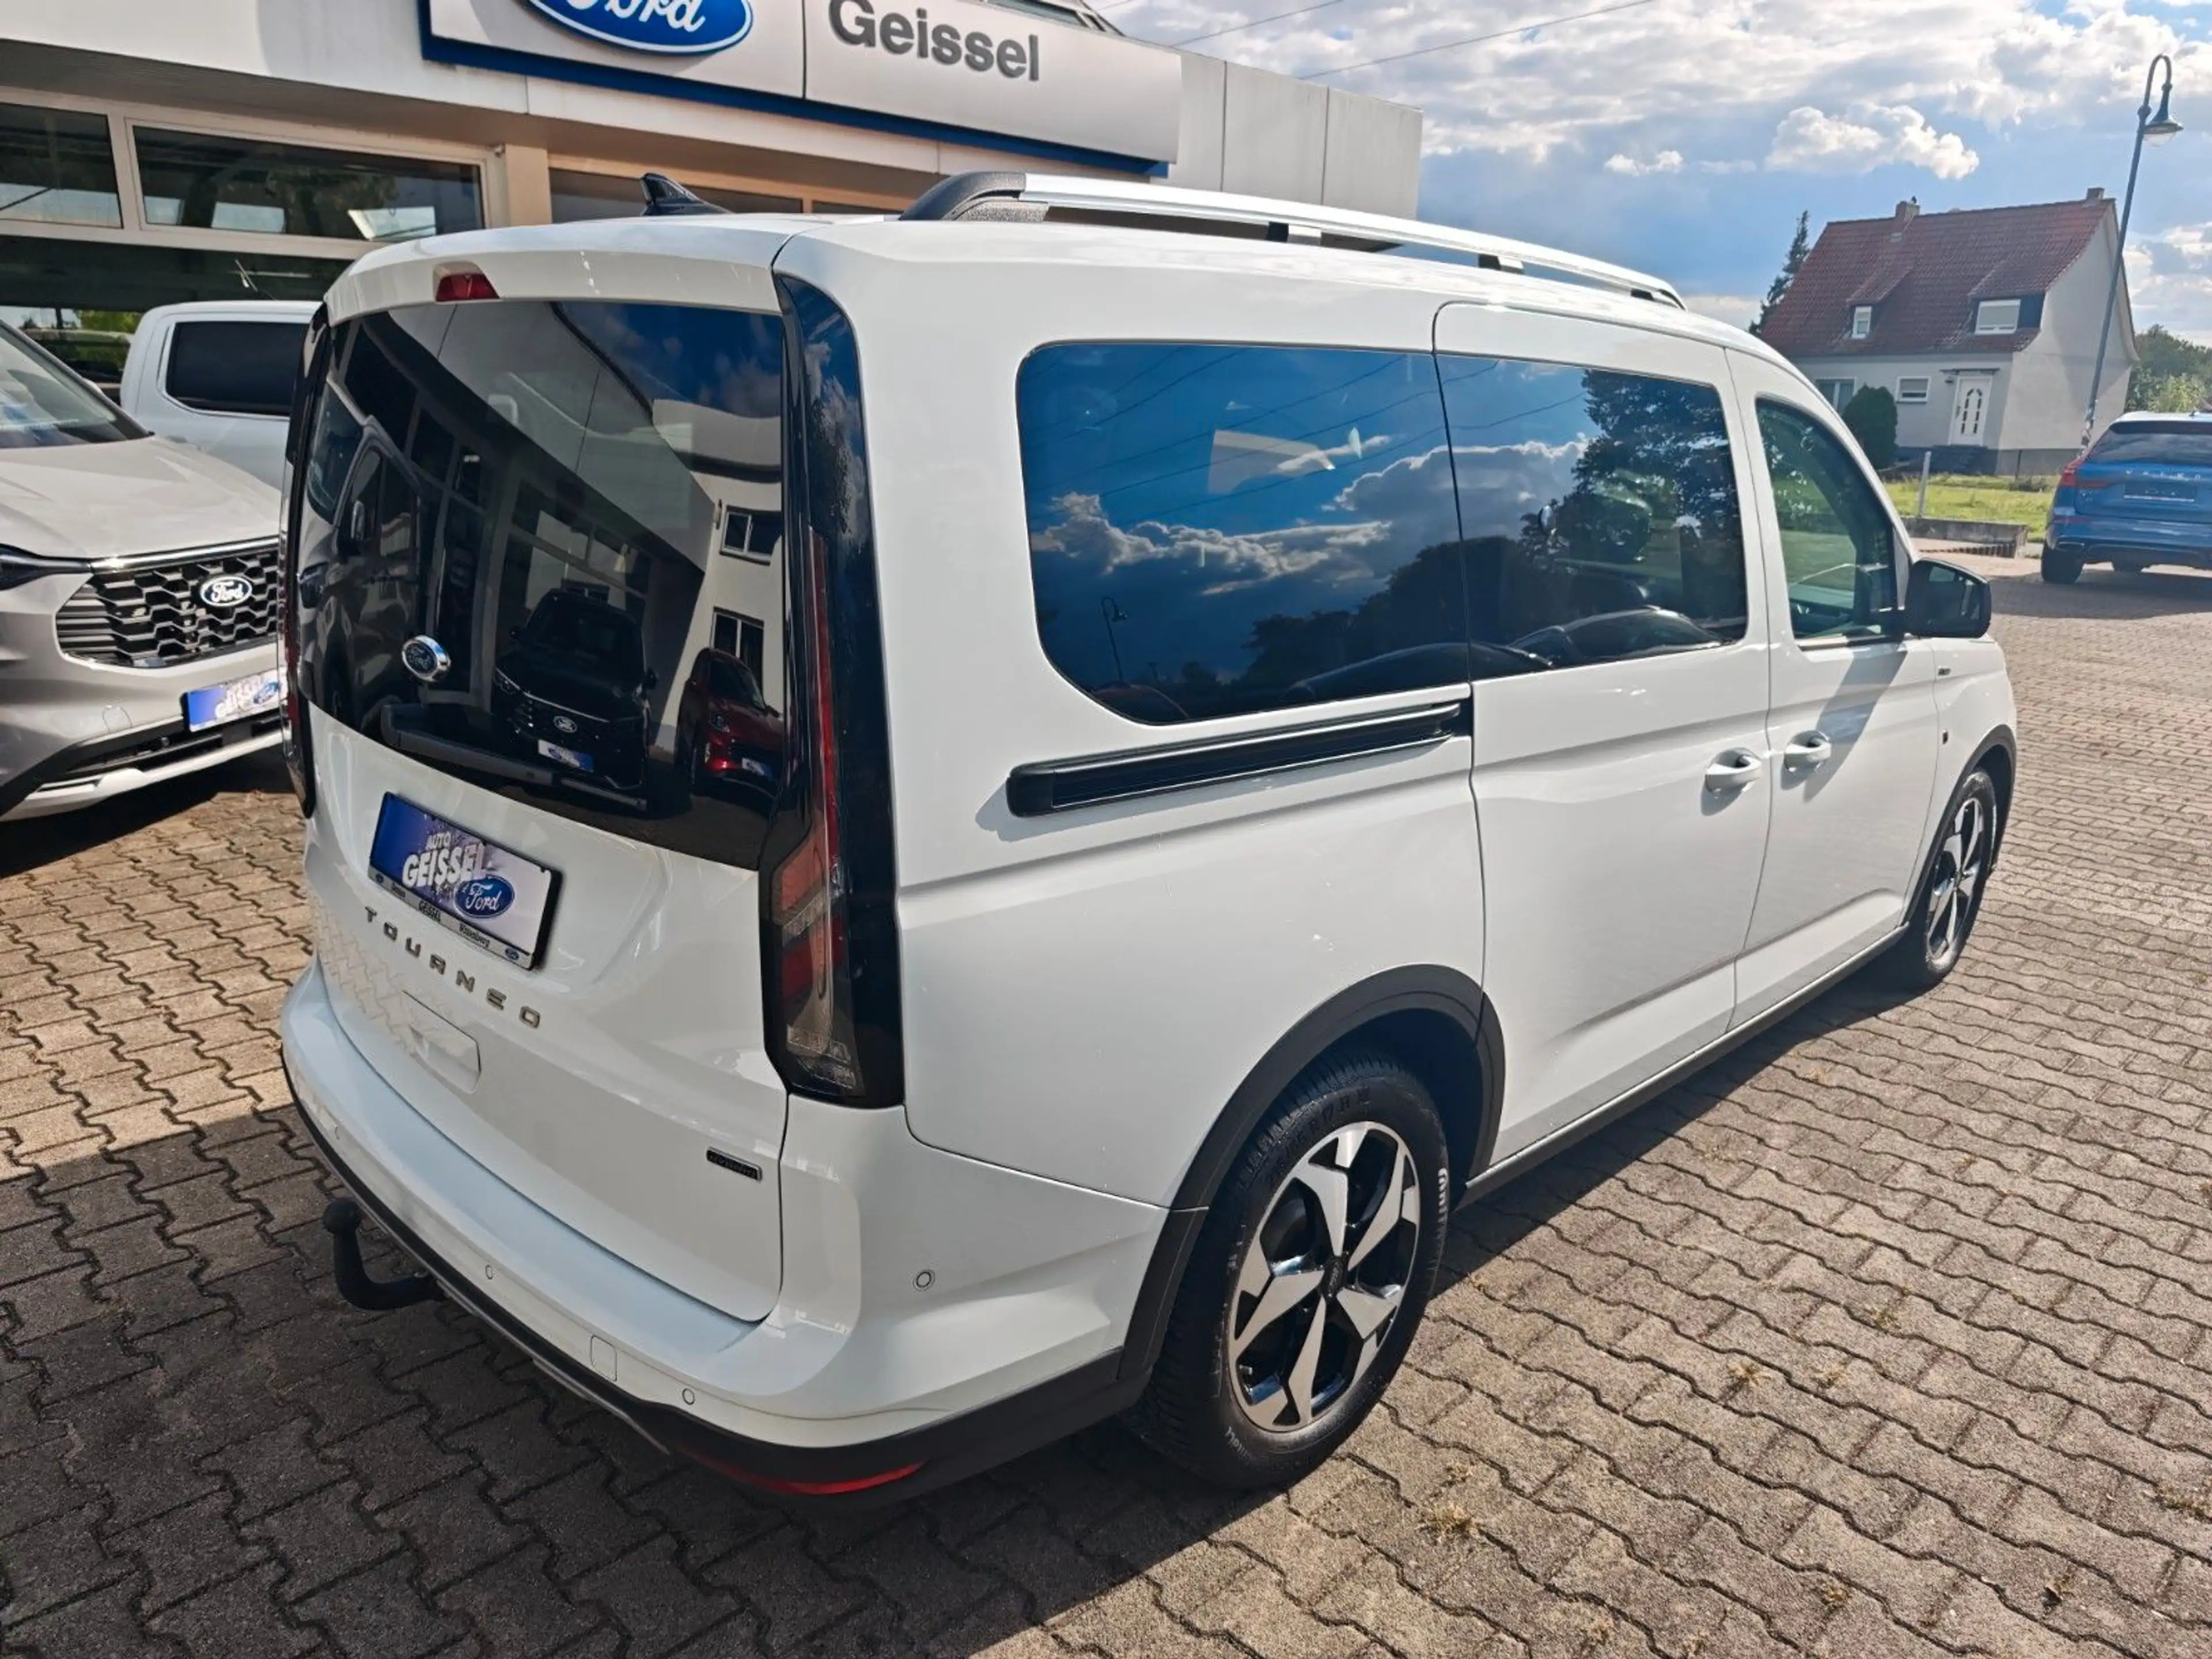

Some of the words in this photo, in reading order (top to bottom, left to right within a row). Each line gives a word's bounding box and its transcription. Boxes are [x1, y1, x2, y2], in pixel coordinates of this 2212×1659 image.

[566, 0, 706, 32] ord
[828, 0, 1039, 81] Geissel
[426, 831, 451, 851] AUTO
[402, 843, 486, 888] GEISSEL
[465, 882, 502, 910] Ford
[365, 906, 540, 1029] TOURNEO
